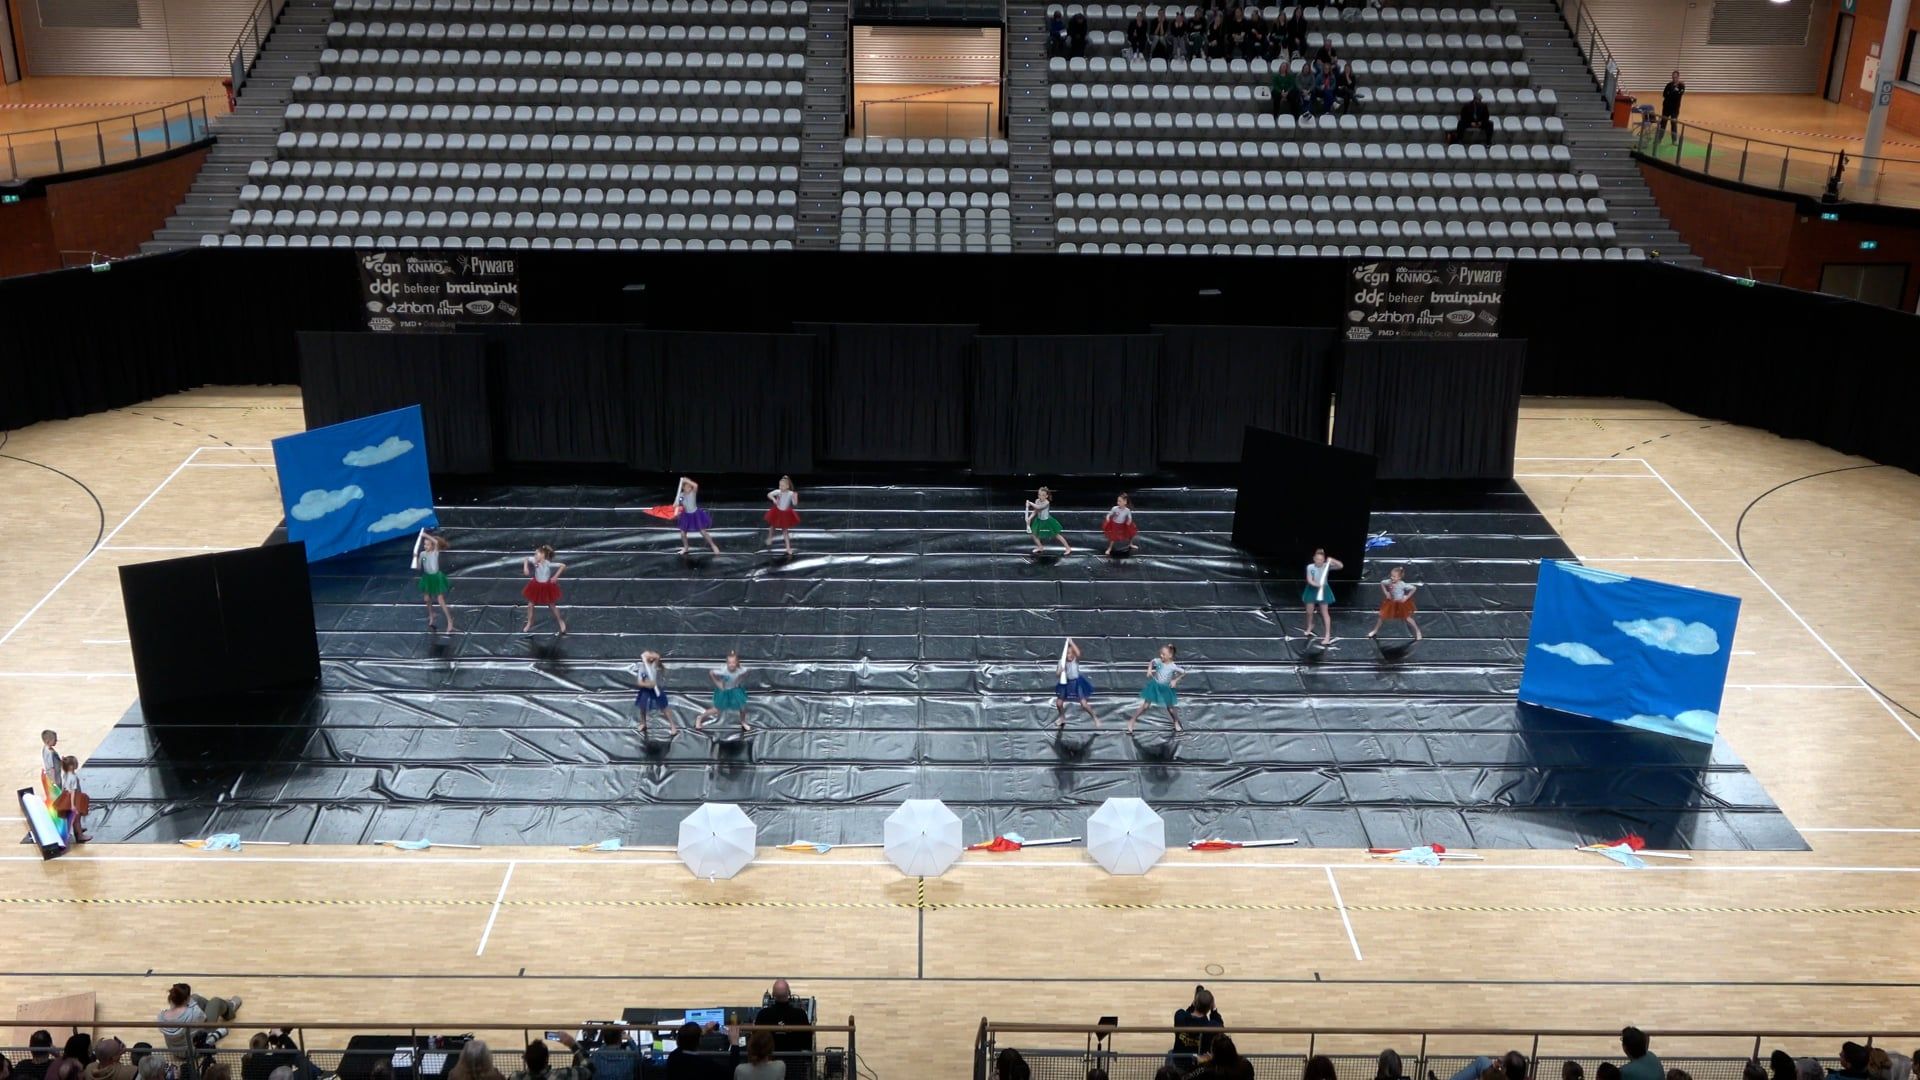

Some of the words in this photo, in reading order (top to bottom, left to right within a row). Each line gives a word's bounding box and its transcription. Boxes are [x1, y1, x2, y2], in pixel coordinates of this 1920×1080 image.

[375, 263, 401, 276] cgn
[408, 263, 443, 273] KNMO
[471, 257, 514, 275] Pyware
[1364, 272, 1389, 285] cgn
[1396, 273, 1430, 283] KNMO
[1460, 267, 1502, 285] Pyware
[370, 279, 400, 297] ddf
[404, 283, 440, 293] beheer
[446, 282, 518, 295] brainpink
[1354, 289, 1385, 307] ddf
[1388, 292, 1424, 303] beheer
[1430, 291, 1502, 305] brainpink
